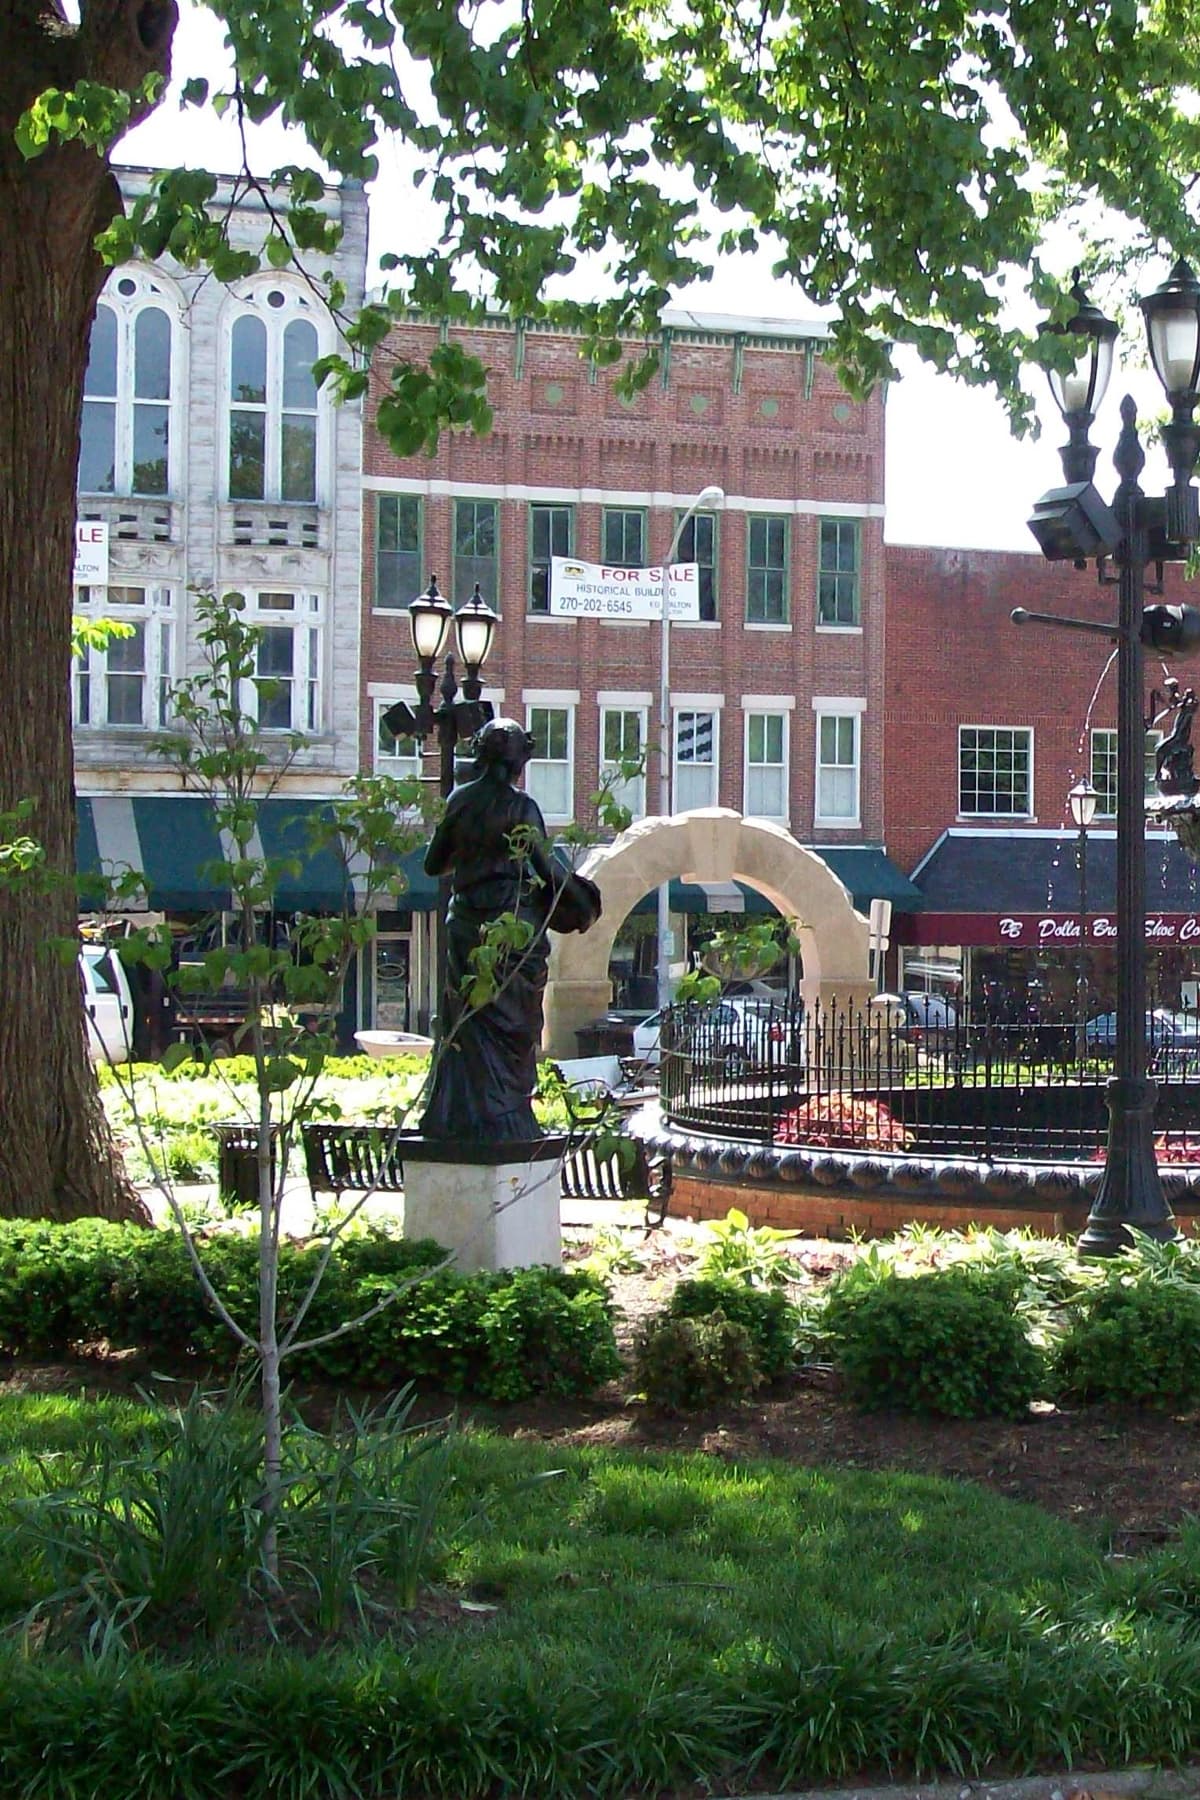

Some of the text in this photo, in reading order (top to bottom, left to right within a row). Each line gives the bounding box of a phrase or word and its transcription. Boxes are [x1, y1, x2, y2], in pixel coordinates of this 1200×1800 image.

[79, 527, 104, 543] LE
[601, 568, 640, 582] FOR
[576, 584, 677, 597] HISTORICAL BUILDIG
[560, 597, 633, 613] 270-202-6545
[668, 601, 692, 609] ALTON
[1038, 918, 1088, 937] Dolla
[1092, 918, 1118, 937] Bro
[1144, 918, 1175, 937] Shoe
